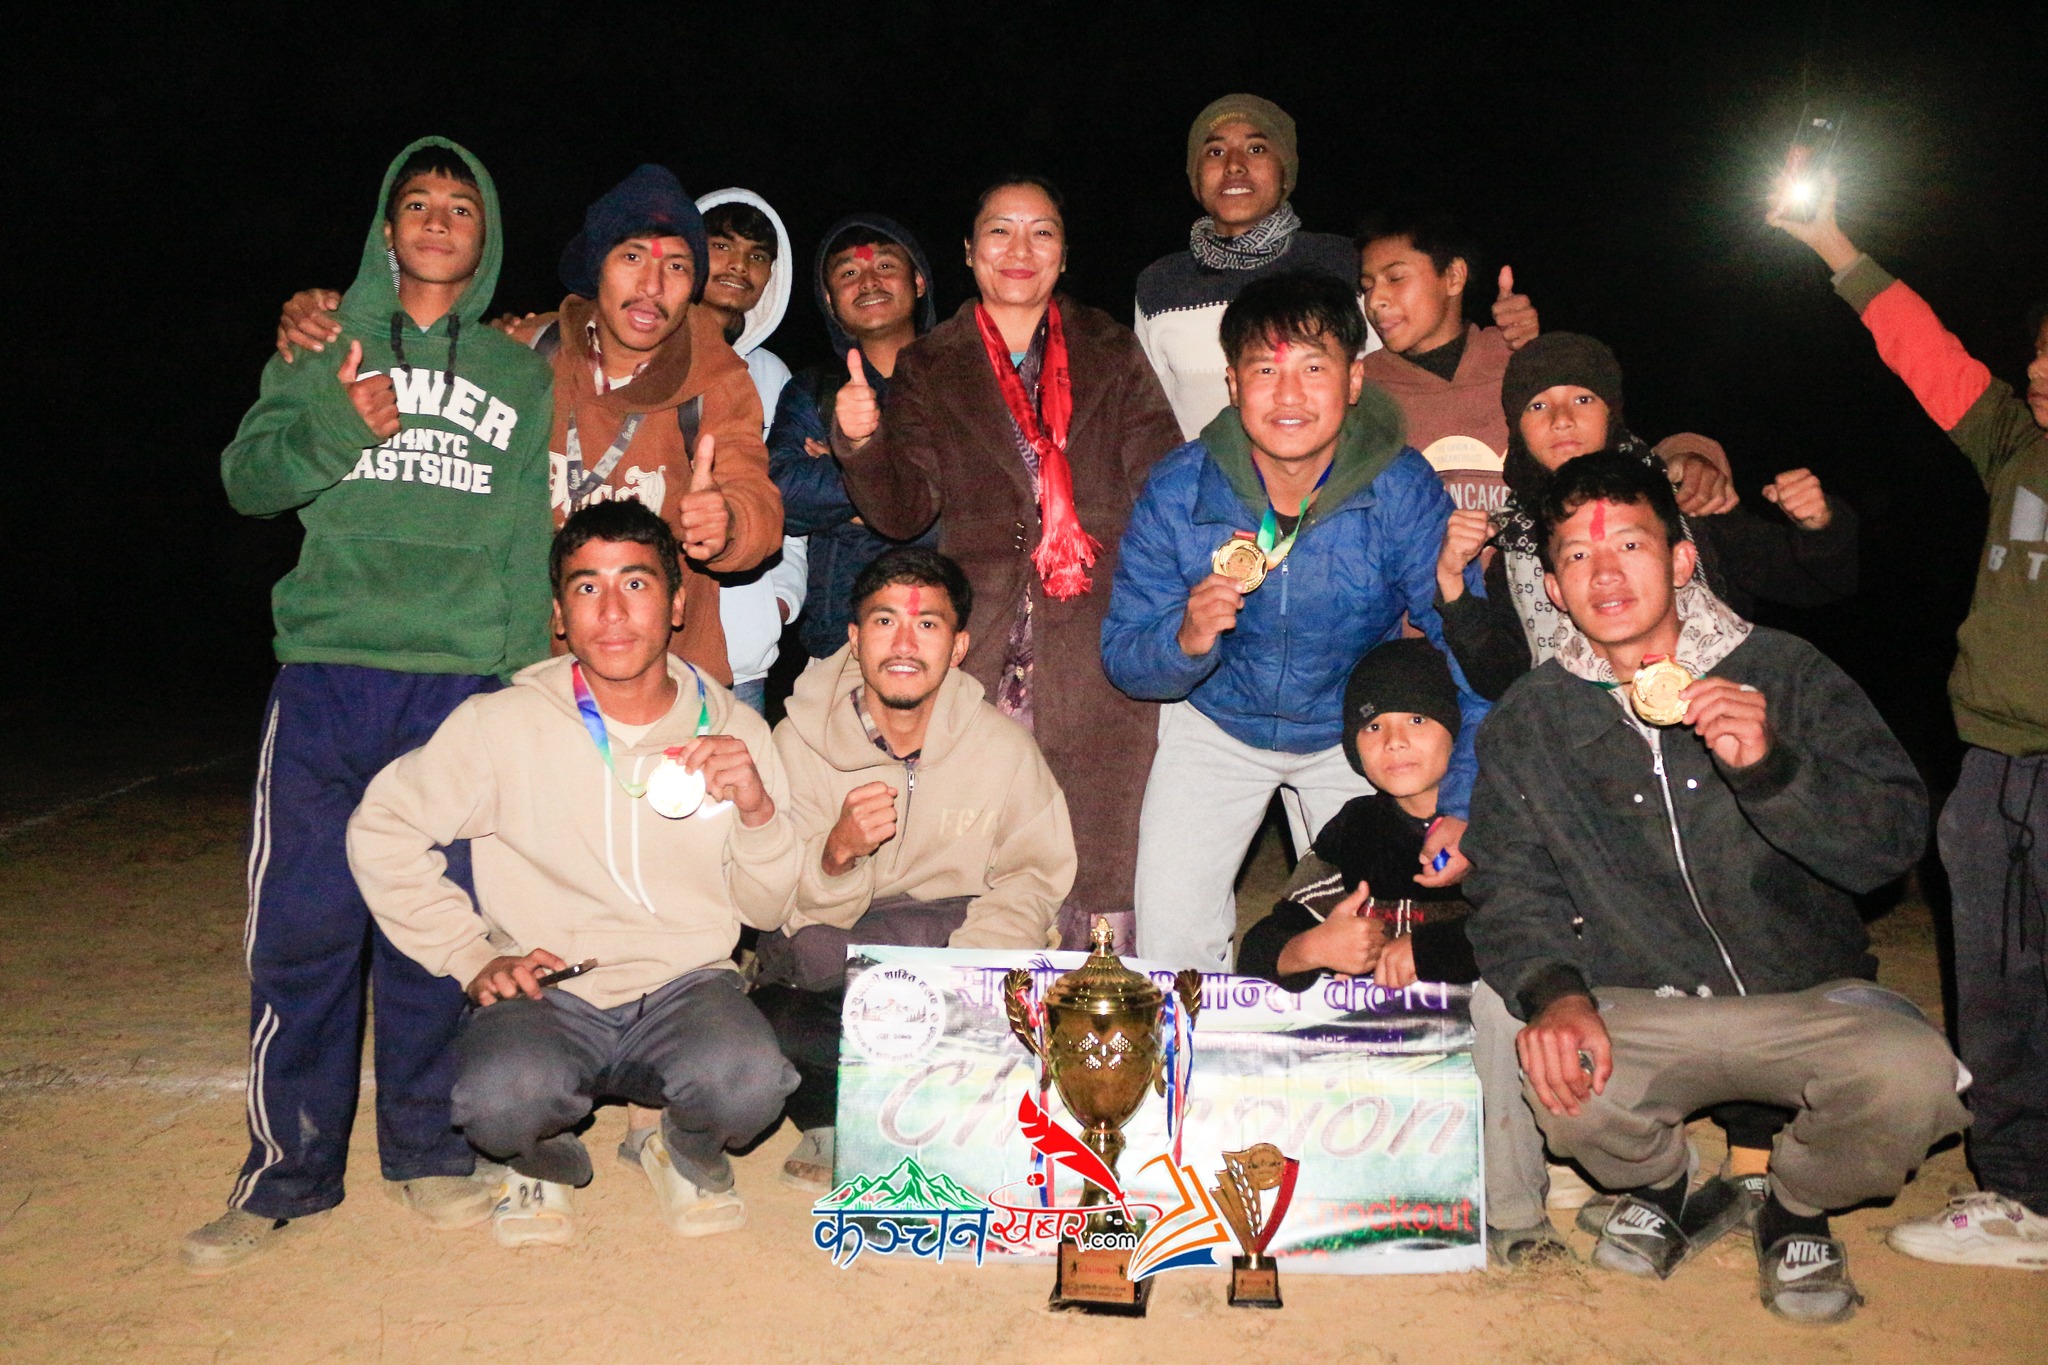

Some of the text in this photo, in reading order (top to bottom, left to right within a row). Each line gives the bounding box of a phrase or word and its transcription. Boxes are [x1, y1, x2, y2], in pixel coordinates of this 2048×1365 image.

[356, 367, 518, 451] WER
[342, 448, 493, 494] ASTSIDE
[1624, 1204, 1666, 1231] NIKE
[1786, 1240, 1832, 1263] NIKE
